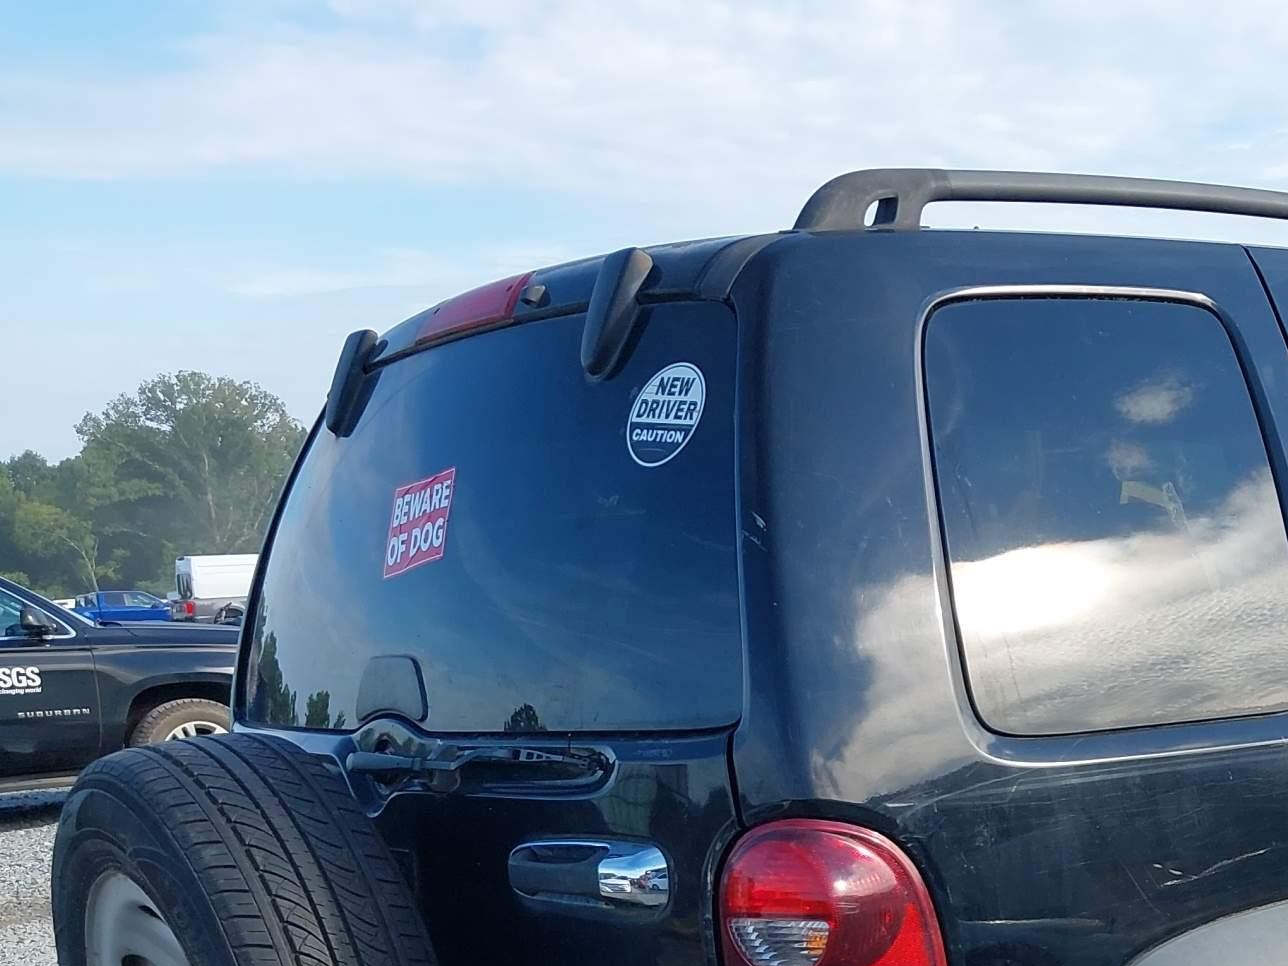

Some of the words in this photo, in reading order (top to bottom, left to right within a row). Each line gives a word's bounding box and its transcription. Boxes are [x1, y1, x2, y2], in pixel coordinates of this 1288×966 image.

[655, 376, 696, 397] NEW
[635, 398, 699, 421] DRIVER
[632, 428, 685, 443] CAUTION
[392, 479, 452, 528] BEWARE
[387, 532, 409, 567] OF
[409, 517, 445, 558] DOG
[17, 707, 91, 719] SUBURBAN
